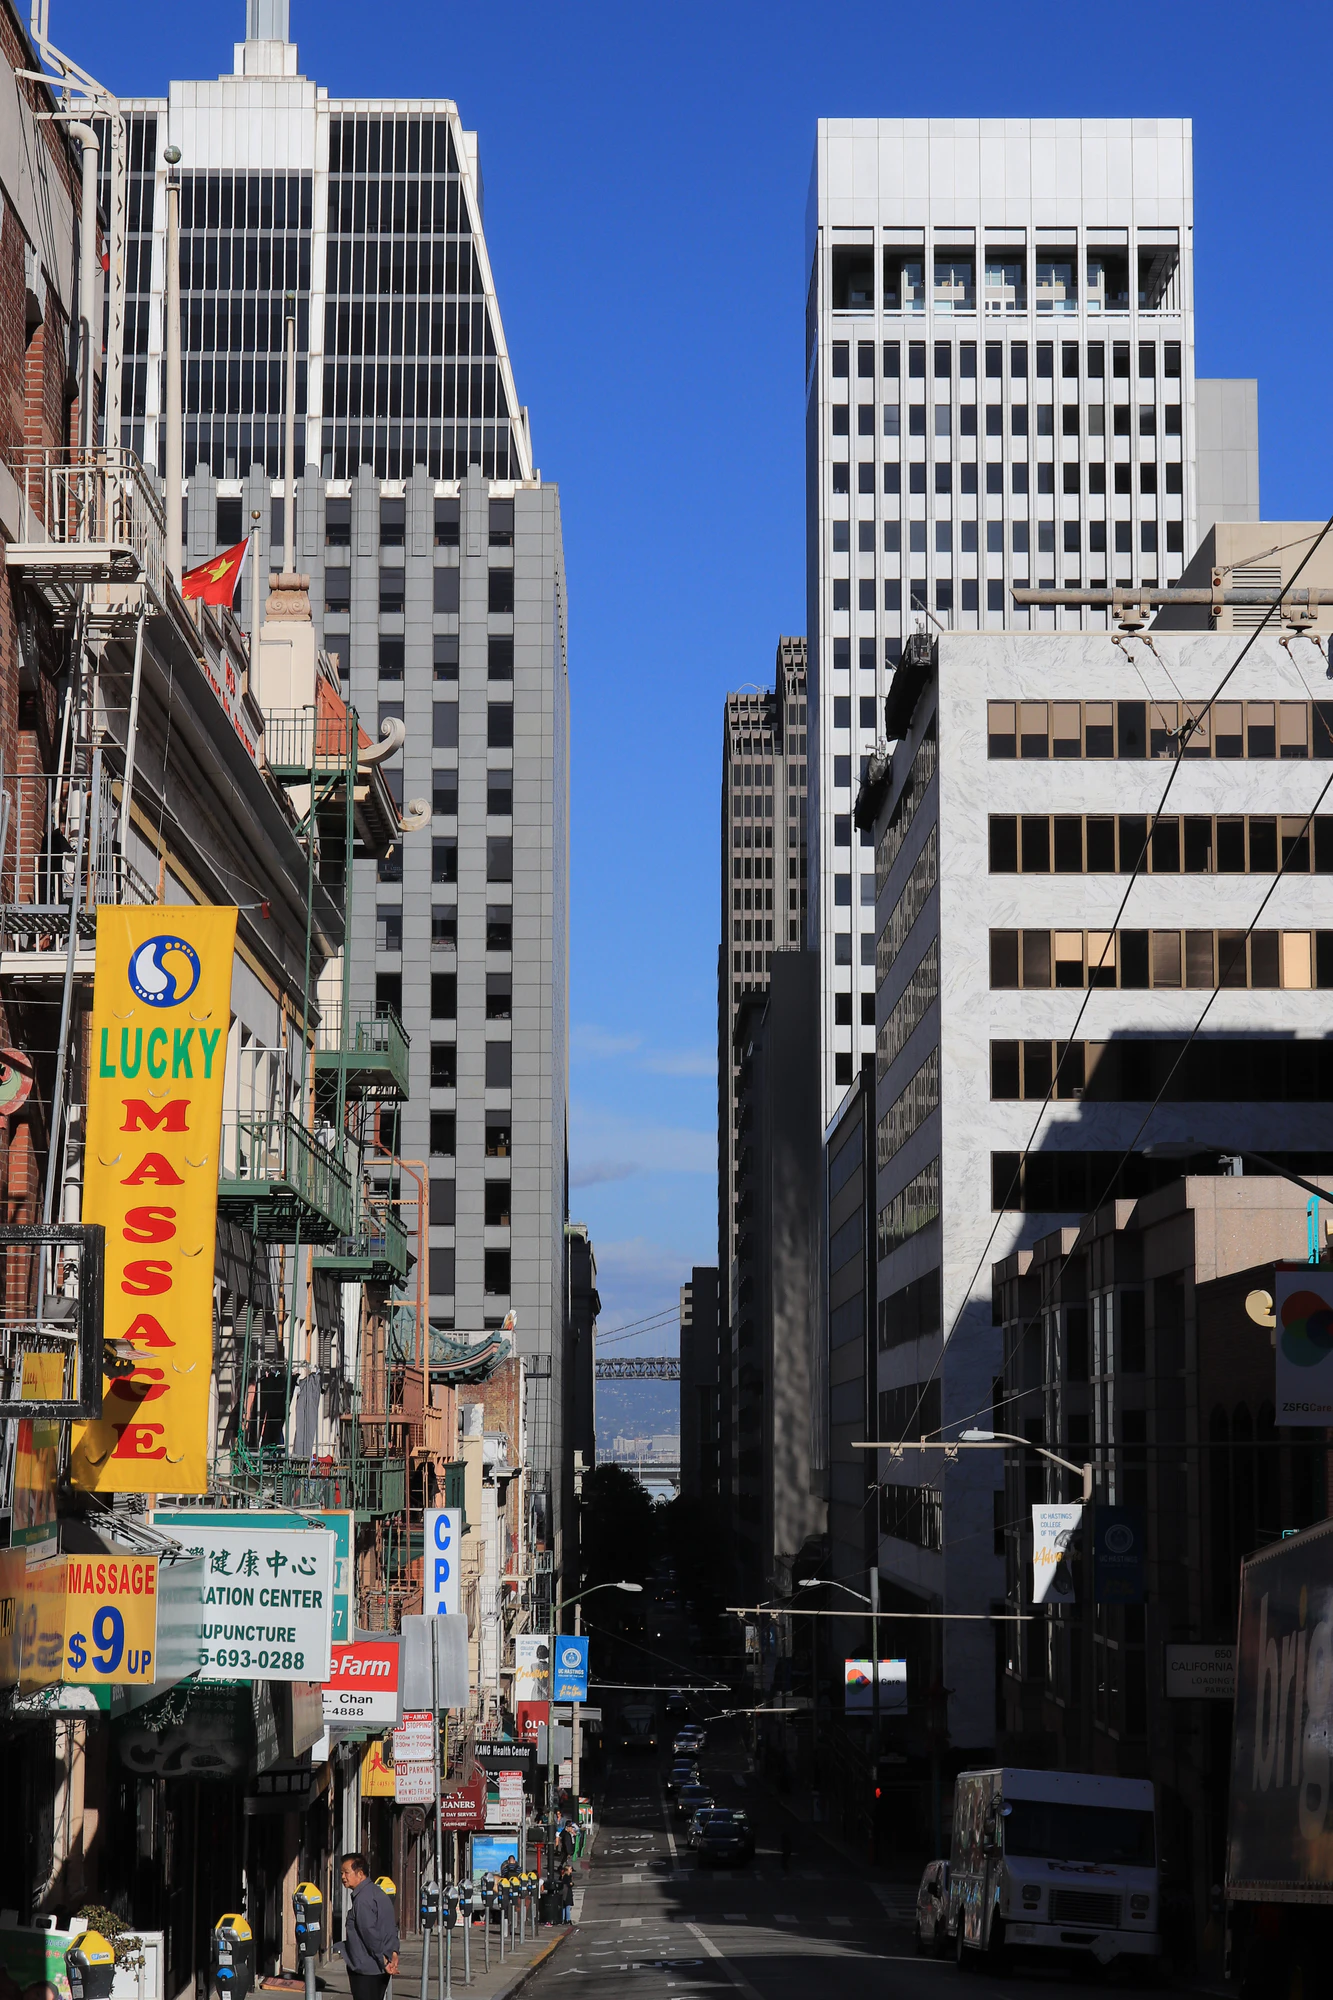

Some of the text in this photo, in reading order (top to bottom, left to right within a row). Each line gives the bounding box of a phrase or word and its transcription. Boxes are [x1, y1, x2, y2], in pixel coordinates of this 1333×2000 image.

[99, 1027, 221, 1079] LUCKY
[111, 1098, 192, 1461] MASSAGE
[185, 1546, 317, 1579] 健康中心
[1034, 1546, 1082, 1566] Advo
[68, 1563, 155, 1595] MASSAGE
[259, 1588, 323, 1609] CENTER
[127, 1650, 152, 1674] UP
[1214, 1649, 1232, 1659] 650
[339, 1655, 391, 1676] Farm
[1171, 1661, 1234, 1672] CALIFORNIA
[1191, 1677, 1230, 1685] LOADING
[339, 1693, 373, 1704] Chan
[475, 1745, 530, 1757] KANG Health Center
[396, 1764, 433, 1776] NO PARKING
[1047, 1862, 1118, 1876] FedEx
